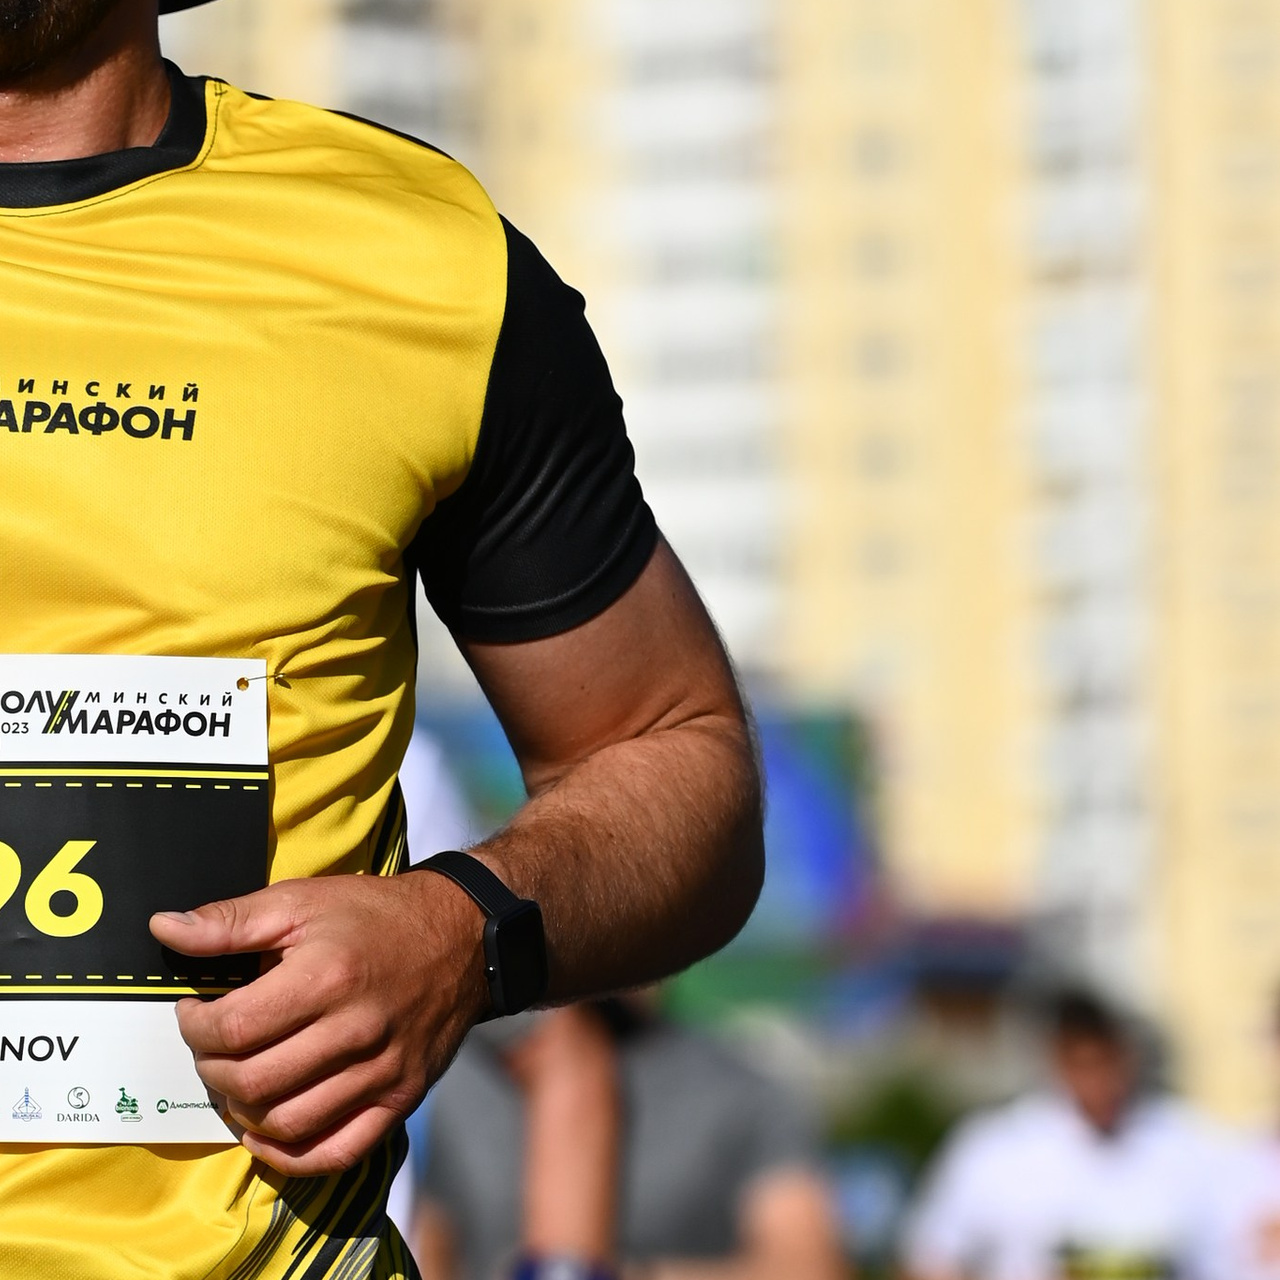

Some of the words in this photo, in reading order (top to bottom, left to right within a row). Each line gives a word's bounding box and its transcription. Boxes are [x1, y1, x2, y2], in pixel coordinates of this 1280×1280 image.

[84, 690, 233, 707] МИНСКИЙ
[56, 706, 232, 738] МАРАФОН
[56, 1113, 100, 1122] DARIDA
